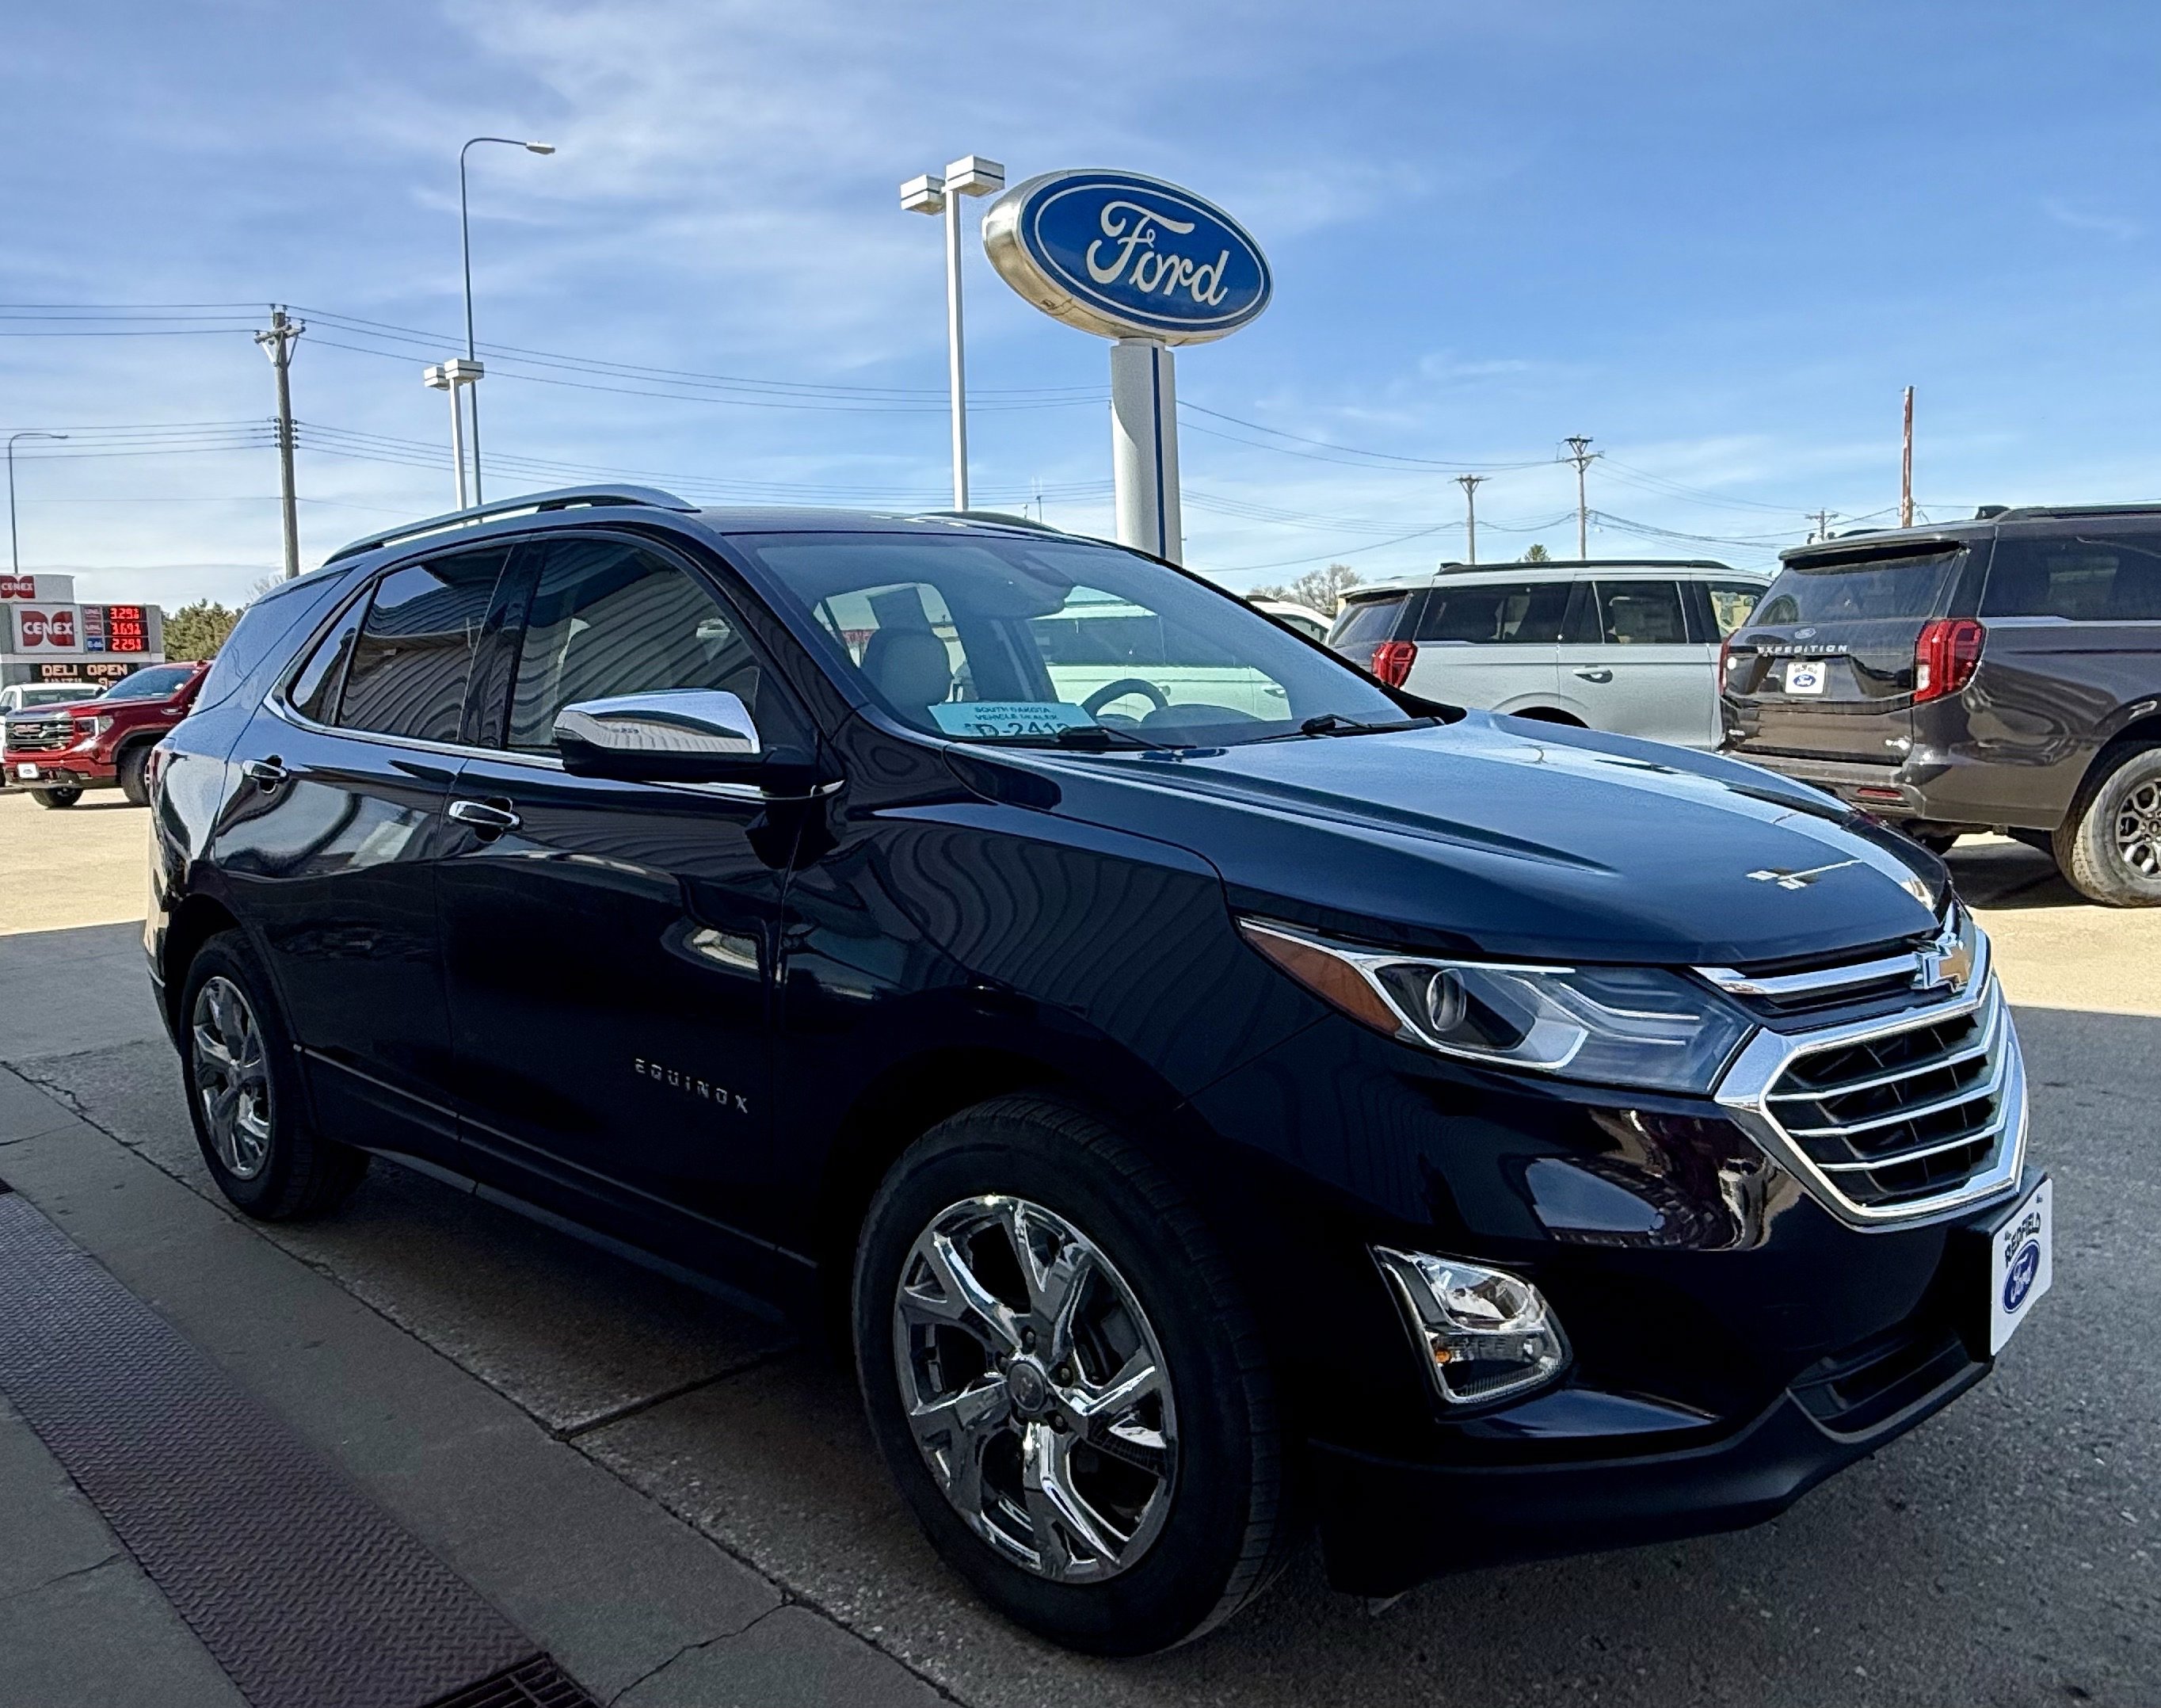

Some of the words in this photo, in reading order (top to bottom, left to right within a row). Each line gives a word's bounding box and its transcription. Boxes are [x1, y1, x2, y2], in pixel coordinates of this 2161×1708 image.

[1086, 200, 1229, 306] Ford
[1, 582, 33, 591] CENEX
[23, 622, 73, 635] CENEX
[1756, 645, 1848, 655] EXPEDITION
[42, 664, 78, 677] DELI
[86, 664, 128, 676] OPEN
[635, 1058, 749, 1114] EQUINOX
